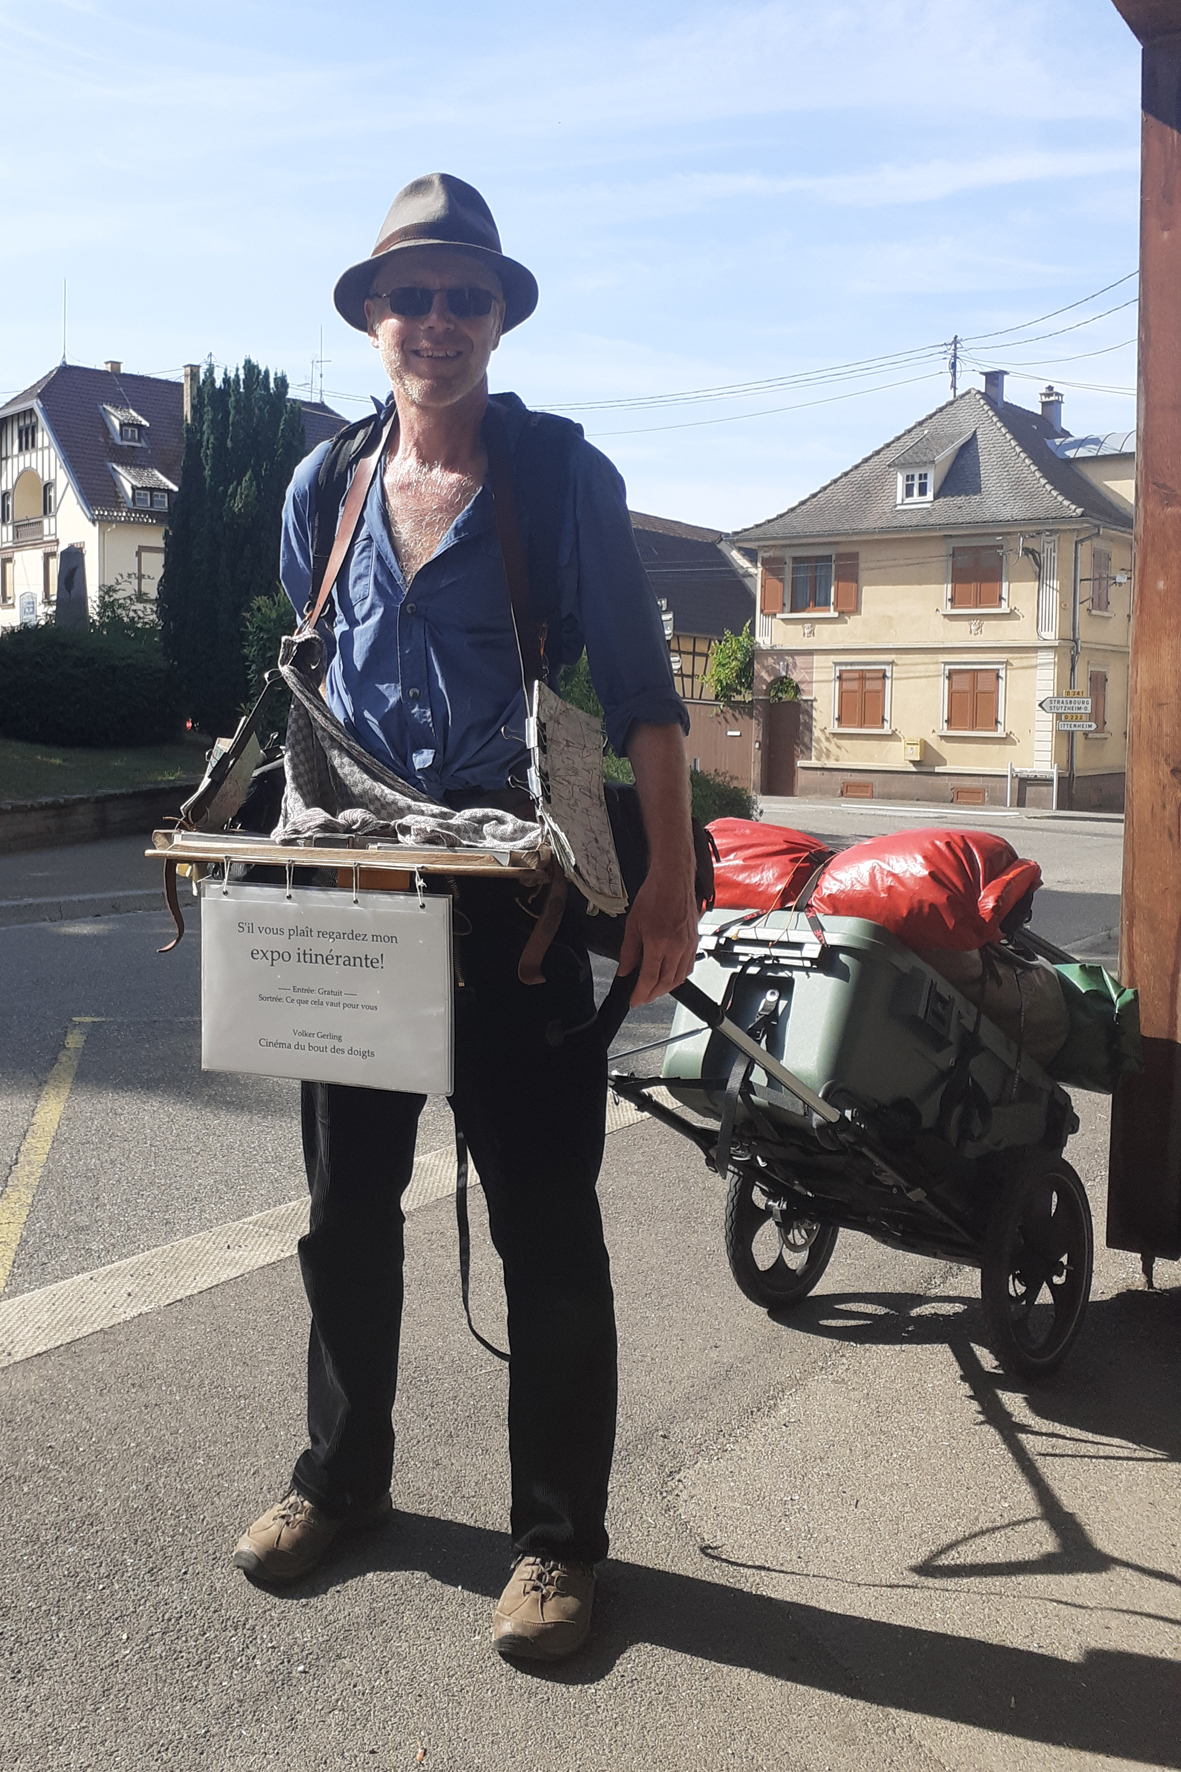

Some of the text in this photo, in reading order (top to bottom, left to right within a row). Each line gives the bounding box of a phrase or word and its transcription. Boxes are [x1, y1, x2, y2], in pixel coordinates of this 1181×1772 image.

[237, 921, 399, 944] S'il vous plaît regardez mon
[250, 947, 385, 970] expo itinérante!
[292, 985, 343, 997] Entrée: Gratuit
[285, 995, 295, 1004] Ce
[296, 998, 309, 1007] que
[310, 998, 324, 1007] cela
[342, 1001, 360, 1011] pour
[360, 1003, 378, 1011] vous
[292, 1029, 343, 1043] Volker Gerling
[258, 1037, 376, 1060] Cinéma du bout des doigts
